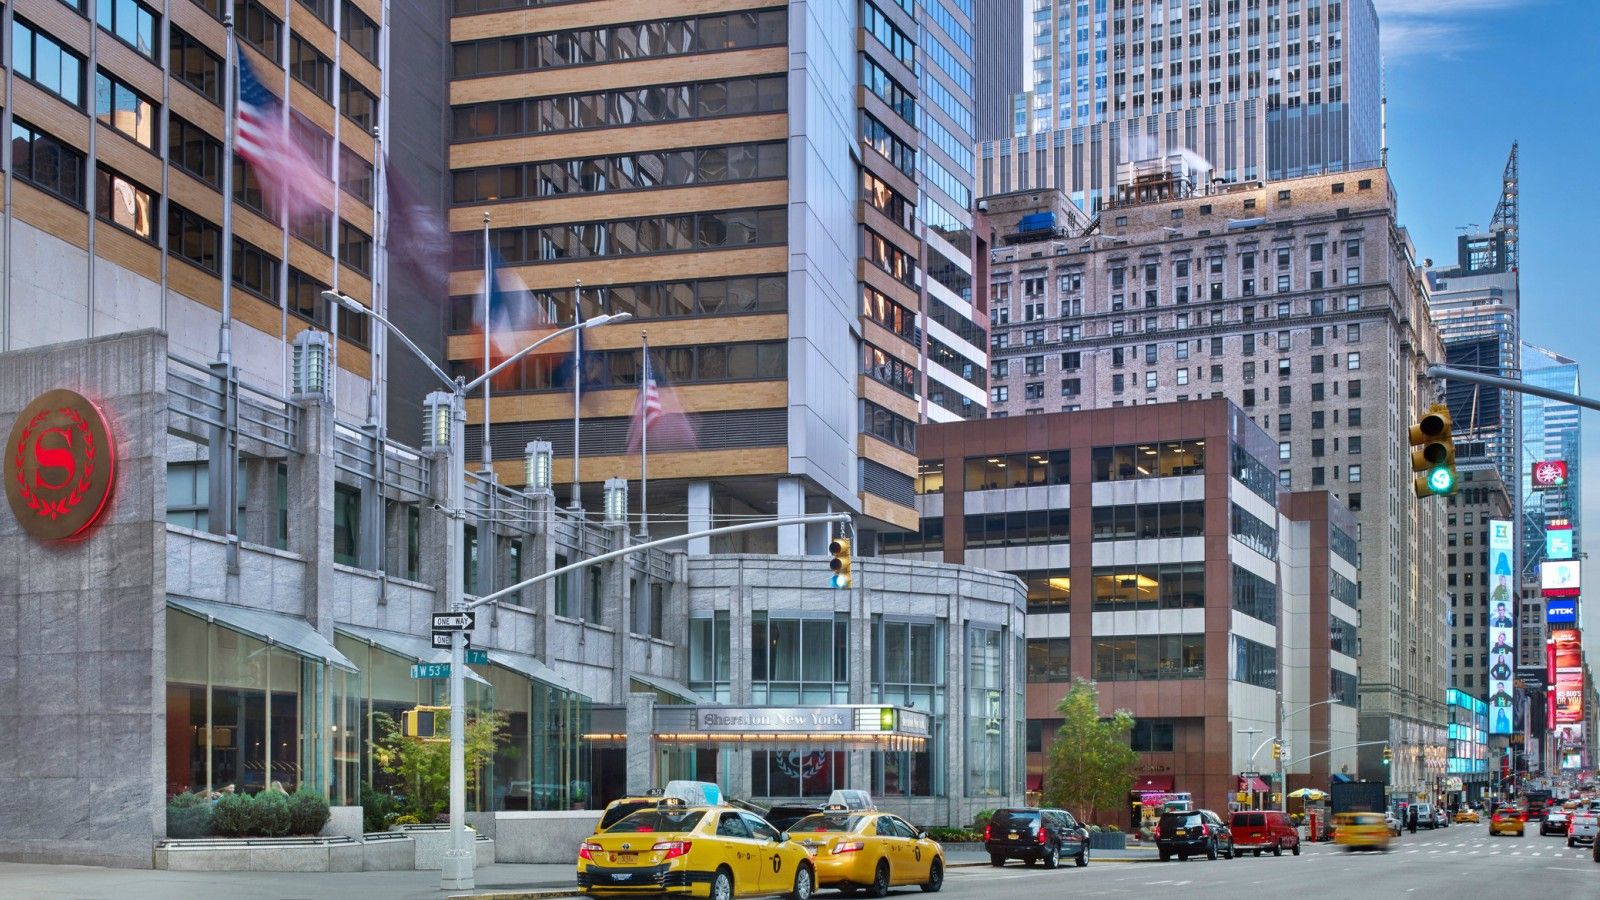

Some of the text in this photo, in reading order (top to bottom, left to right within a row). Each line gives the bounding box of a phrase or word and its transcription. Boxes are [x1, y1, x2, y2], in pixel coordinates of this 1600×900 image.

[35, 427, 76, 490] S
[455, 617, 468, 625] WAY
[473, 652, 478, 662] 7
[420, 665, 427, 677] W
[429, 665, 441, 676] 53
[704, 711, 843, 727] Sheraton New York
